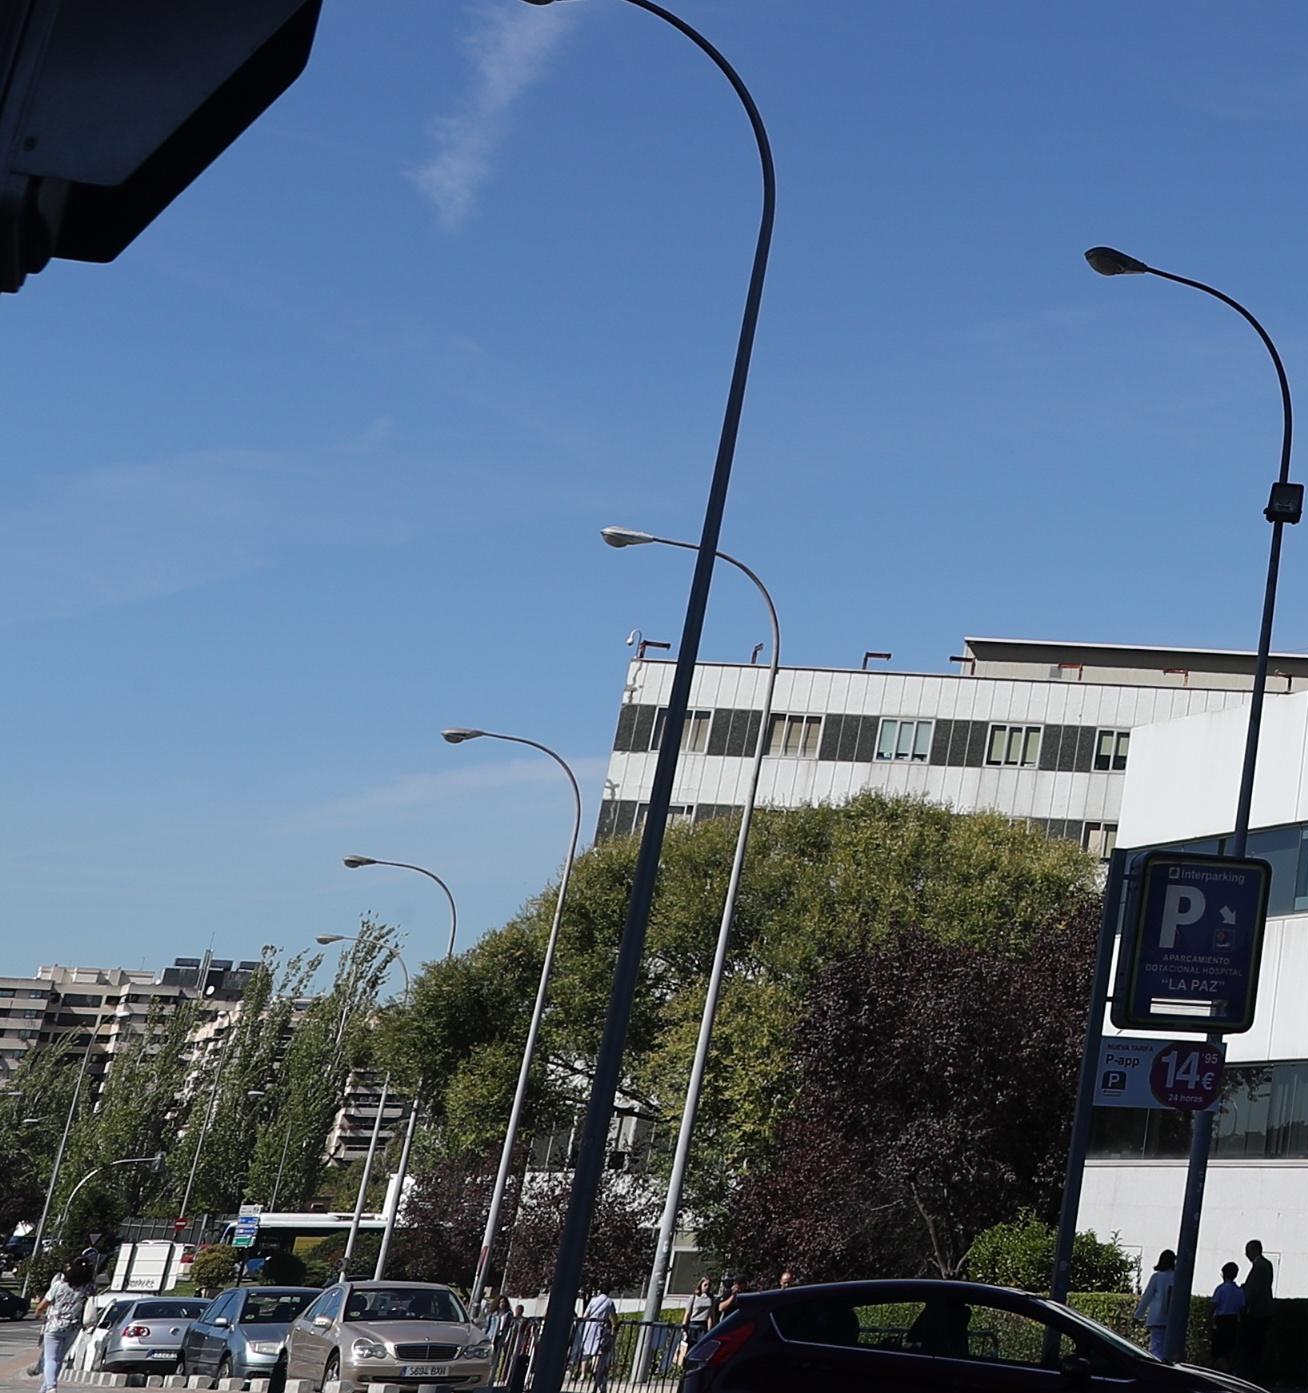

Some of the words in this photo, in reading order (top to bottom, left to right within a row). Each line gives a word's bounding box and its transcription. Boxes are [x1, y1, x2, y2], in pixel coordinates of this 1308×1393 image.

[1159, 884, 1206, 948] P
[1162, 953, 1231, 965] APARCAMIENTO
[1202, 968, 1243, 977] HOSPITAL
[1105, 1054, 1140, 1068] P-app
[1161, 1050, 1201, 1089] 14
[1108, 1073, 1120, 1088] P
[1201, 1072, 1216, 1091] €
[1179, 1094, 1203, 1103] horas
